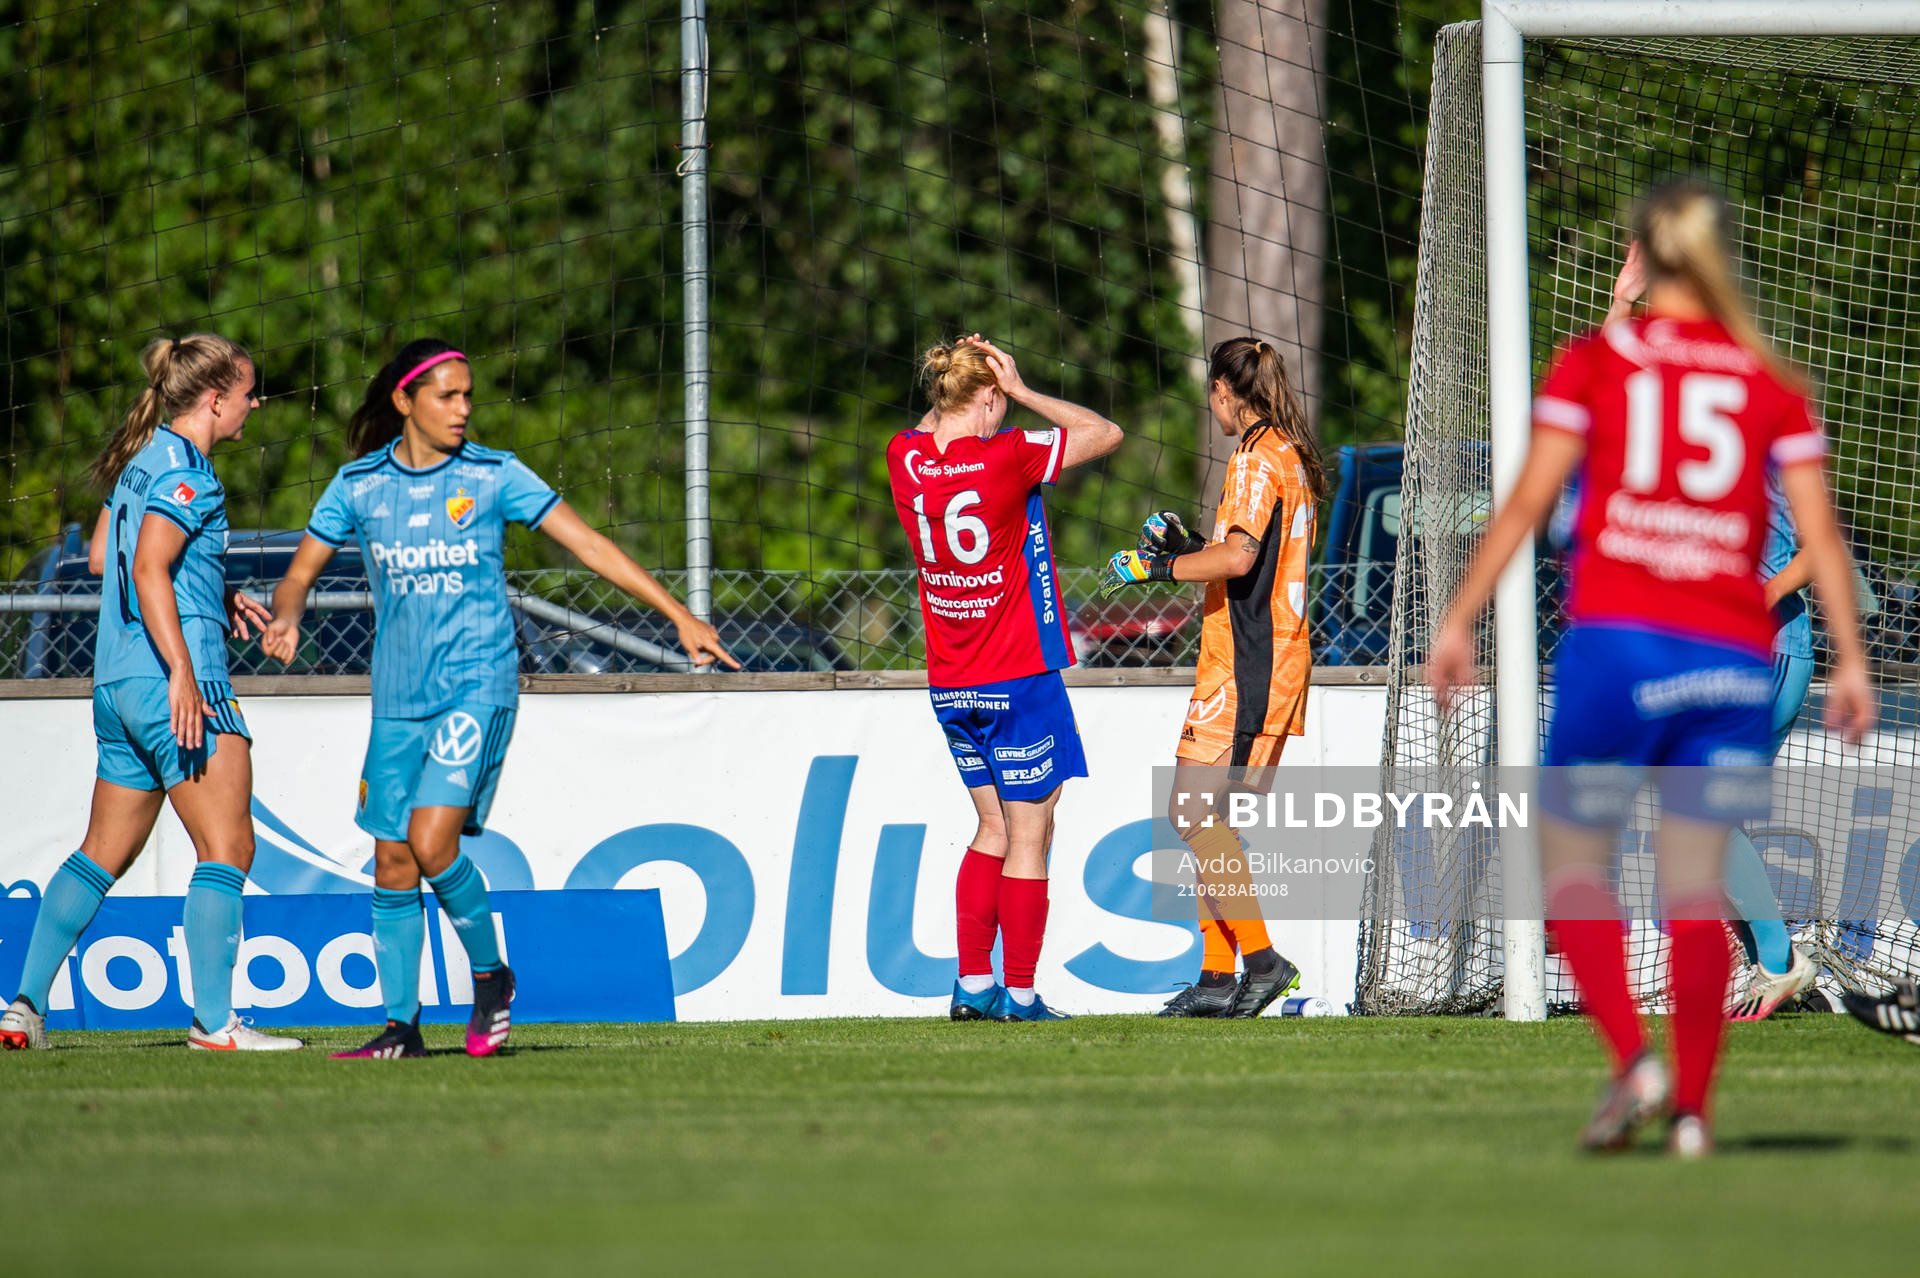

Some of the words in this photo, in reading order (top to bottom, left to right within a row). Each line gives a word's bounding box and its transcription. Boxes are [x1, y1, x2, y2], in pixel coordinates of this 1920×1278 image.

[1622, 368, 1748, 500] 15
[943, 462, 985, 477] Sjukhem
[913, 490, 990, 565] 16
[1029, 521, 1045, 557] Tak
[371, 538, 479, 569] Prioritet
[921, 566, 1003, 588] furninova
[926, 592, 1004, 609] Motorcentru
[931, 605, 969, 620] Markaryd
[971, 609, 986, 619] AB
[931, 691, 978, 701] TRANSPORT
[953, 700, 1010, 710] SEKTIONEN
[1008, 759, 1051, 780] PEAB
